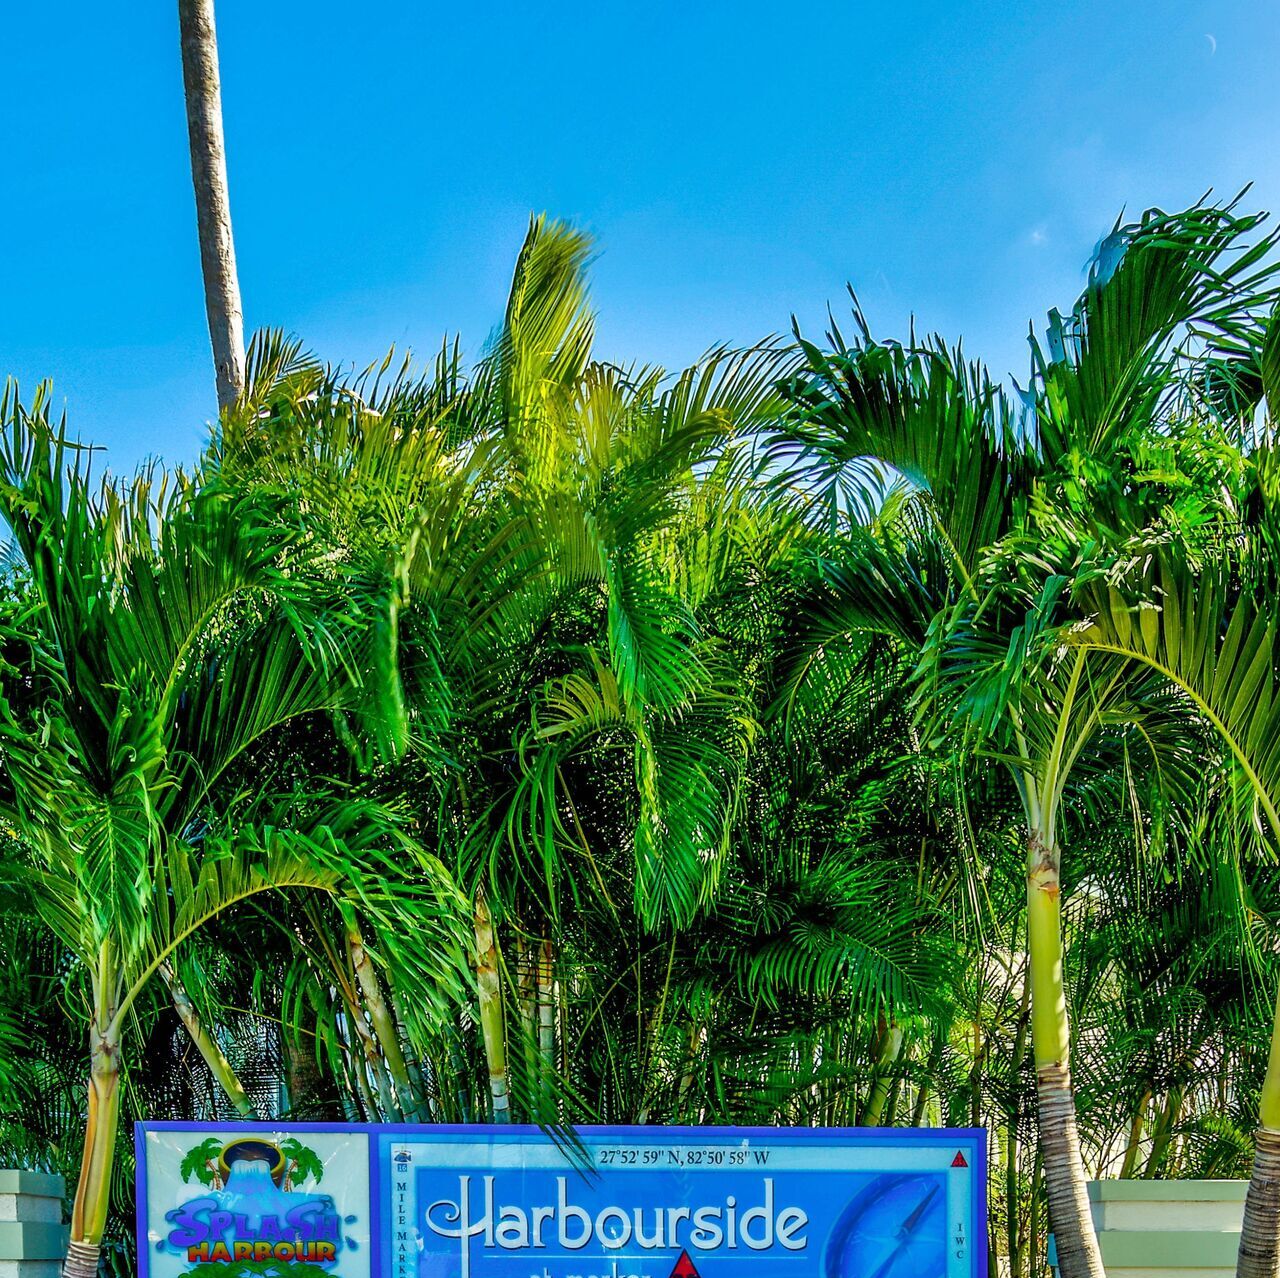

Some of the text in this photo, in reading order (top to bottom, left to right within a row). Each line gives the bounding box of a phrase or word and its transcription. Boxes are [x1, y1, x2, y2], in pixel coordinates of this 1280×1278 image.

[754, 1151, 770, 1165] W
[396, 1182, 407, 1225] MILE
[167, 1198, 340, 1247] SPLASH
[187, 1241, 337, 1263] HARBOUR
